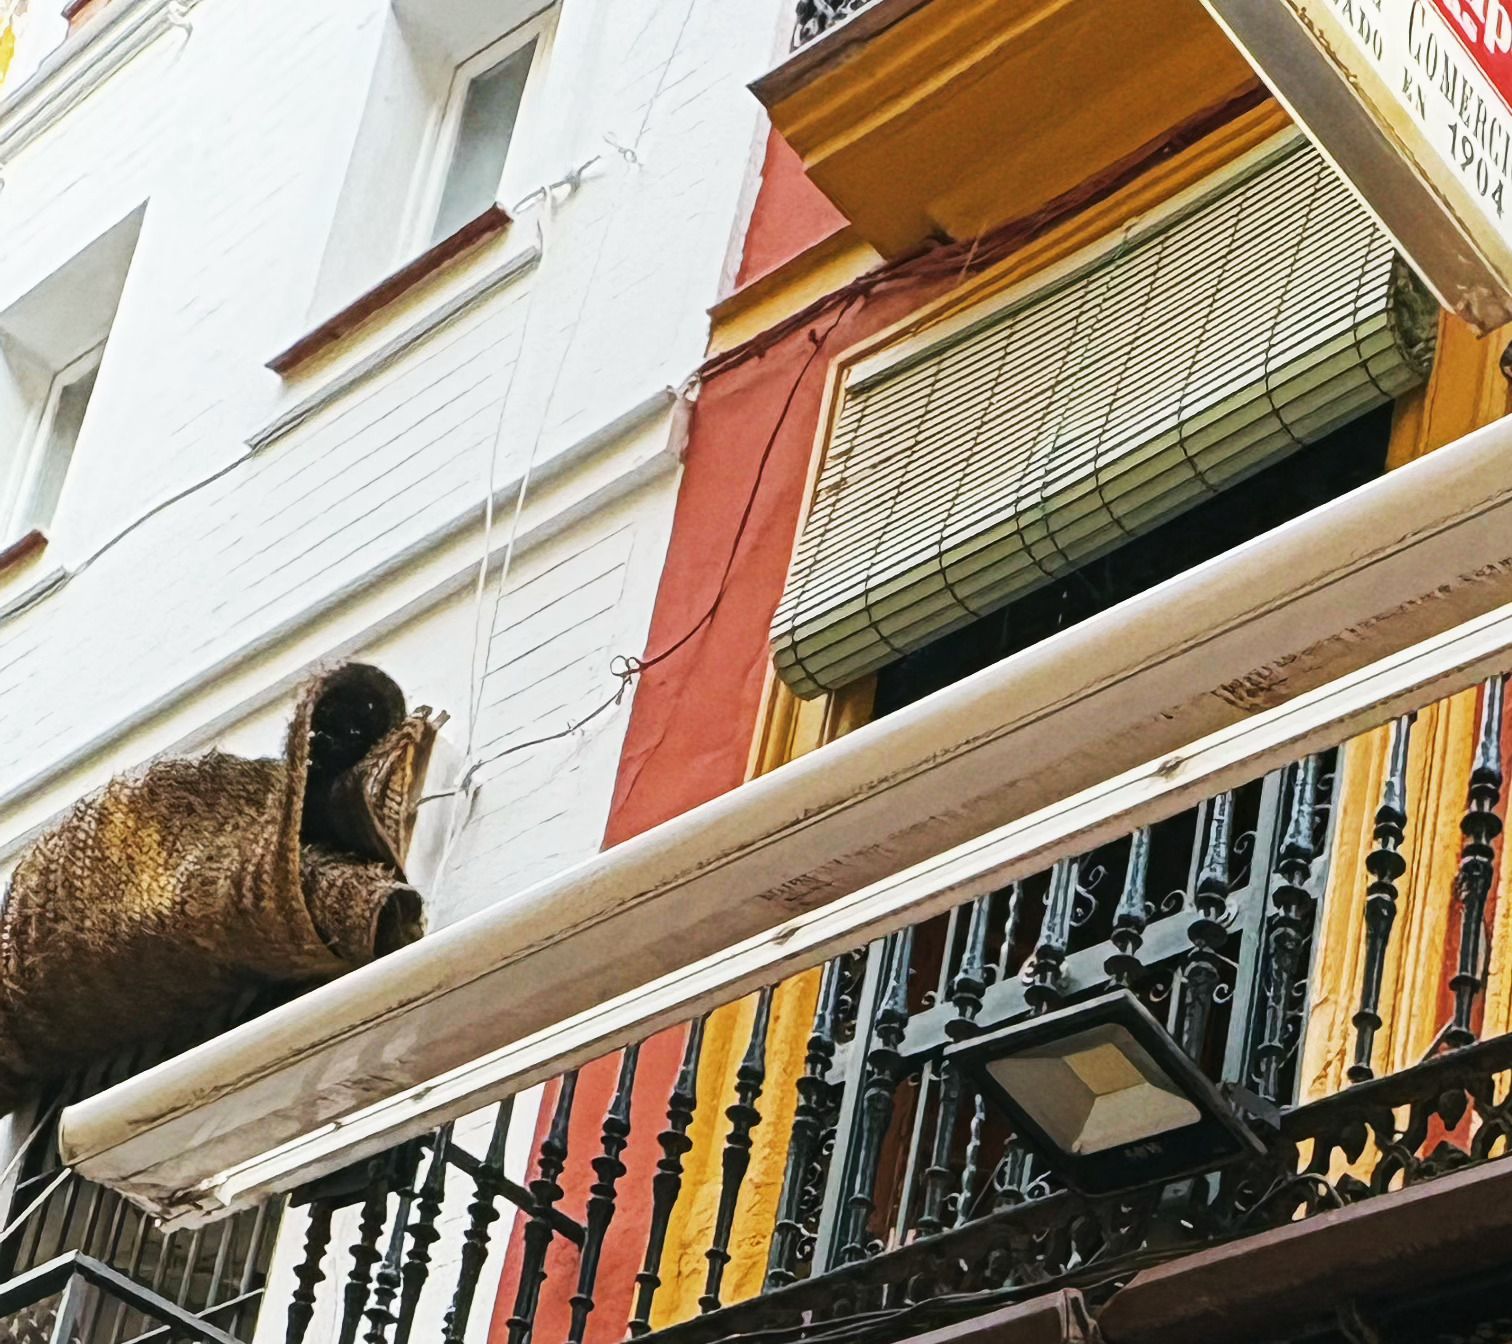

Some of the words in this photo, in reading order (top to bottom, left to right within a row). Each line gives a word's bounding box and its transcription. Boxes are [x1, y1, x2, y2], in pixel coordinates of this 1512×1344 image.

[1334, 0, 1382, 61] ADO
[1402, 66, 1425, 120] EN
[1448, 122, 1505, 219] 1904
